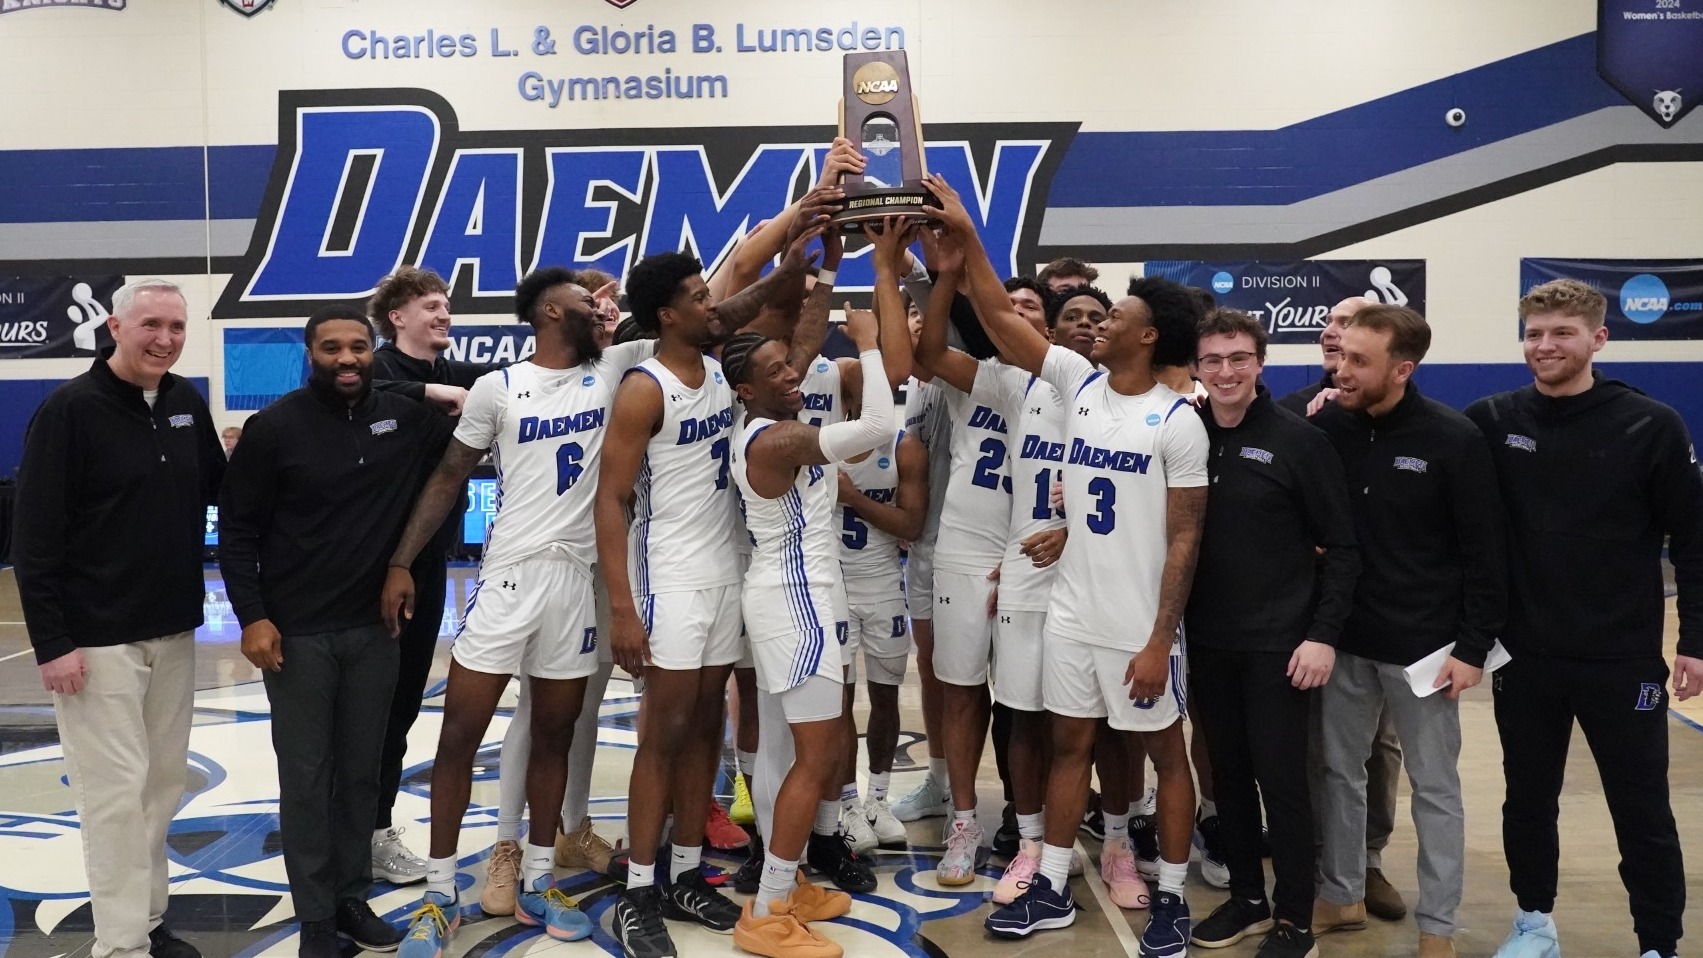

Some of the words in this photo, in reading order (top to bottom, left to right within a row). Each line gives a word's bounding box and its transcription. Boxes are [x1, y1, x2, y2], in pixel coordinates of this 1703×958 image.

[1623, 12, 1664, 20] Women's
[1656, 0, 1680, 9] 2024
[341, 28, 478, 60] Charles
[490, 27, 519, 57] L.
[531, 25, 557, 56] &
[573, 24, 677, 55] Gloria
[692, 23, 723, 54] B.
[736, 21, 906, 52] Lumsden
[518, 67, 729, 108] Gymnasium
[857, 79, 899, 94] NCAA
[849, 197, 884, 209] REGIONAL
[885, 196, 924, 205] CHAMPION
[1242, 276, 1307, 288] DIVISION
[1312, 276, 1320, 288] II
[0, 320, 48, 343] URS
[1265, 297, 1329, 334] YOUR
[443, 335, 536, 364] NCAA
[517, 407, 606, 444] DAEMEN
[676, 406, 733, 446] DAEME
[711, 436, 730, 491] 7
[1020, 434, 1066, 463] DAE
[1068, 437, 1153, 475] DAEMEN
[556, 441, 584, 497] 6
[1086, 476, 1117, 536] 3
[842, 505, 869, 551] 5
